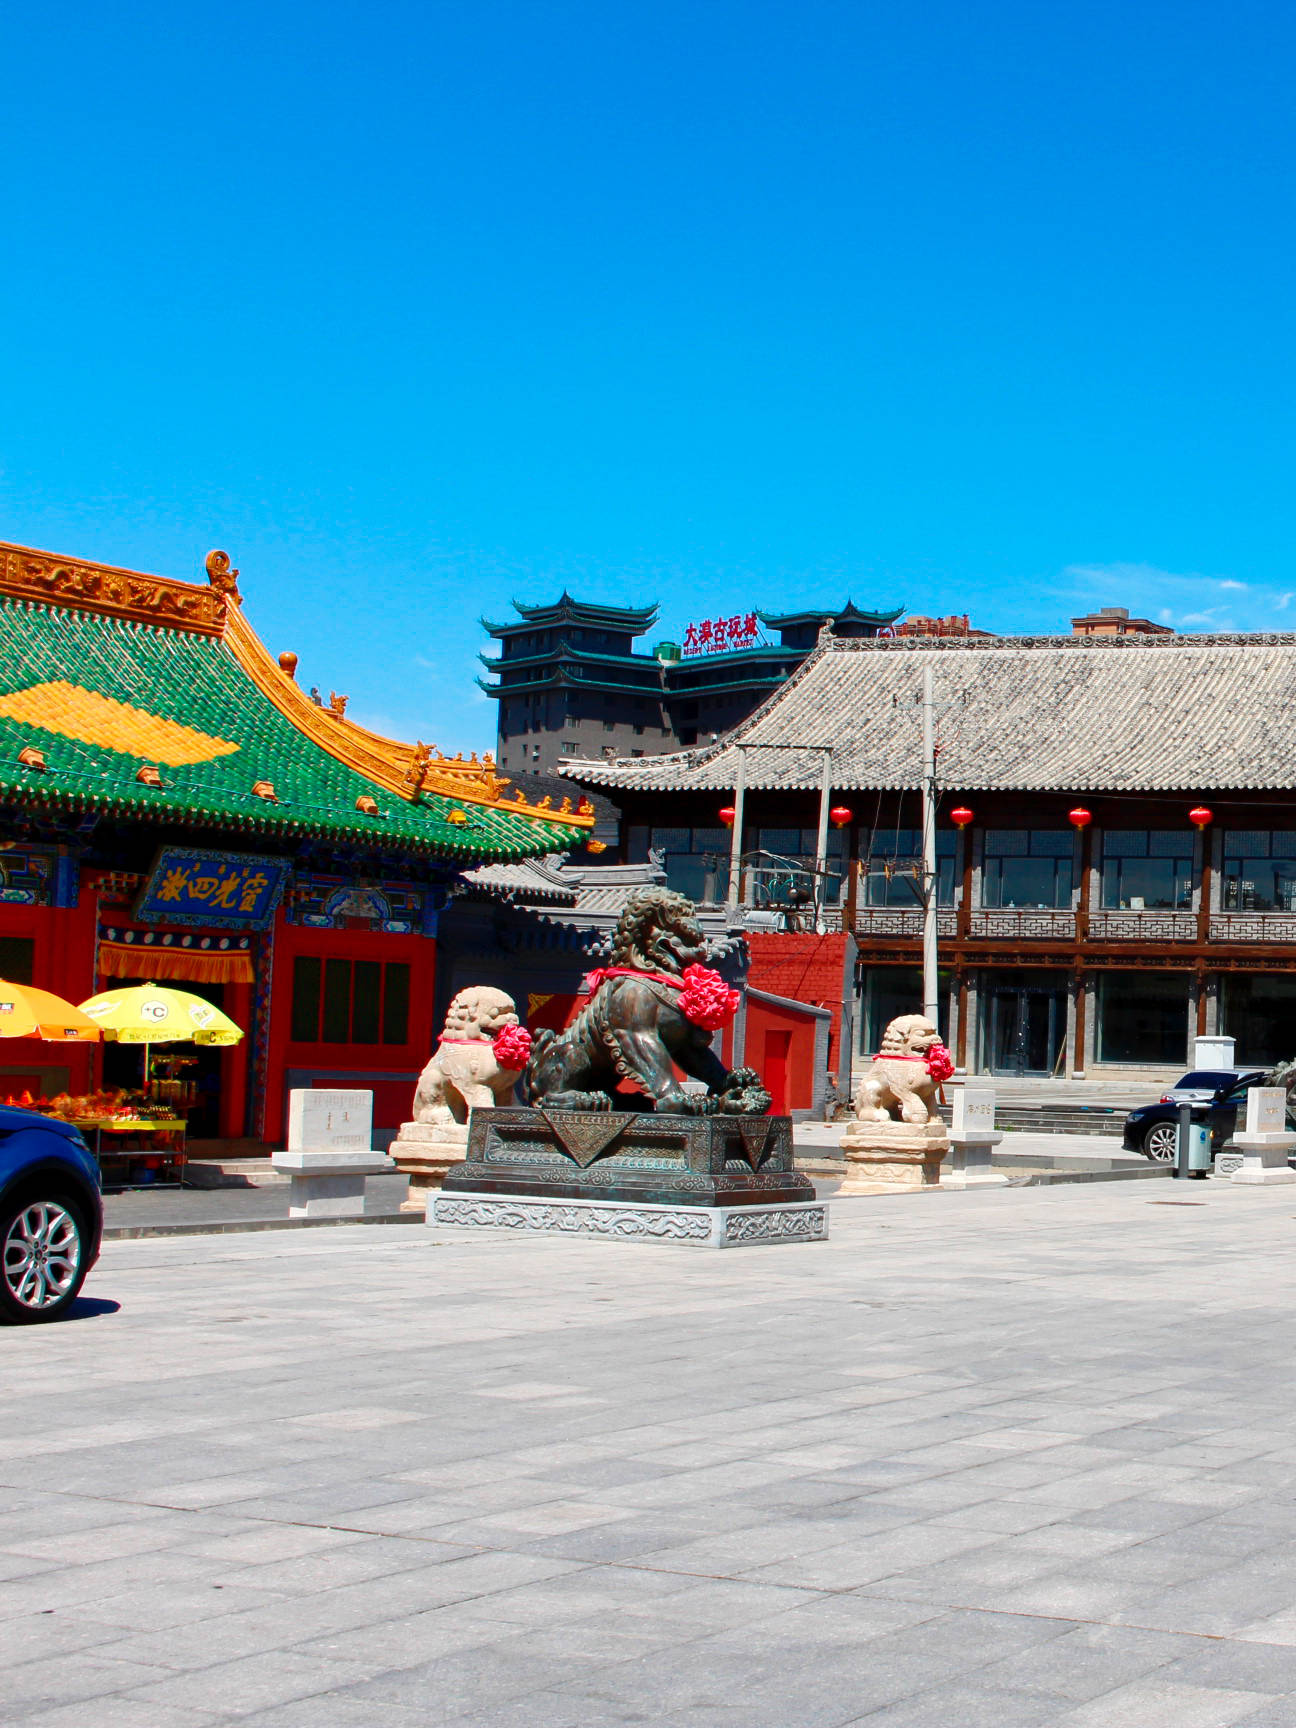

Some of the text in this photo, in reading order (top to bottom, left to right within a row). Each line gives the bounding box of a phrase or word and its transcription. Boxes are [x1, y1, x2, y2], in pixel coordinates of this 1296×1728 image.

[683, 612, 758, 647] 大漠古玩城
